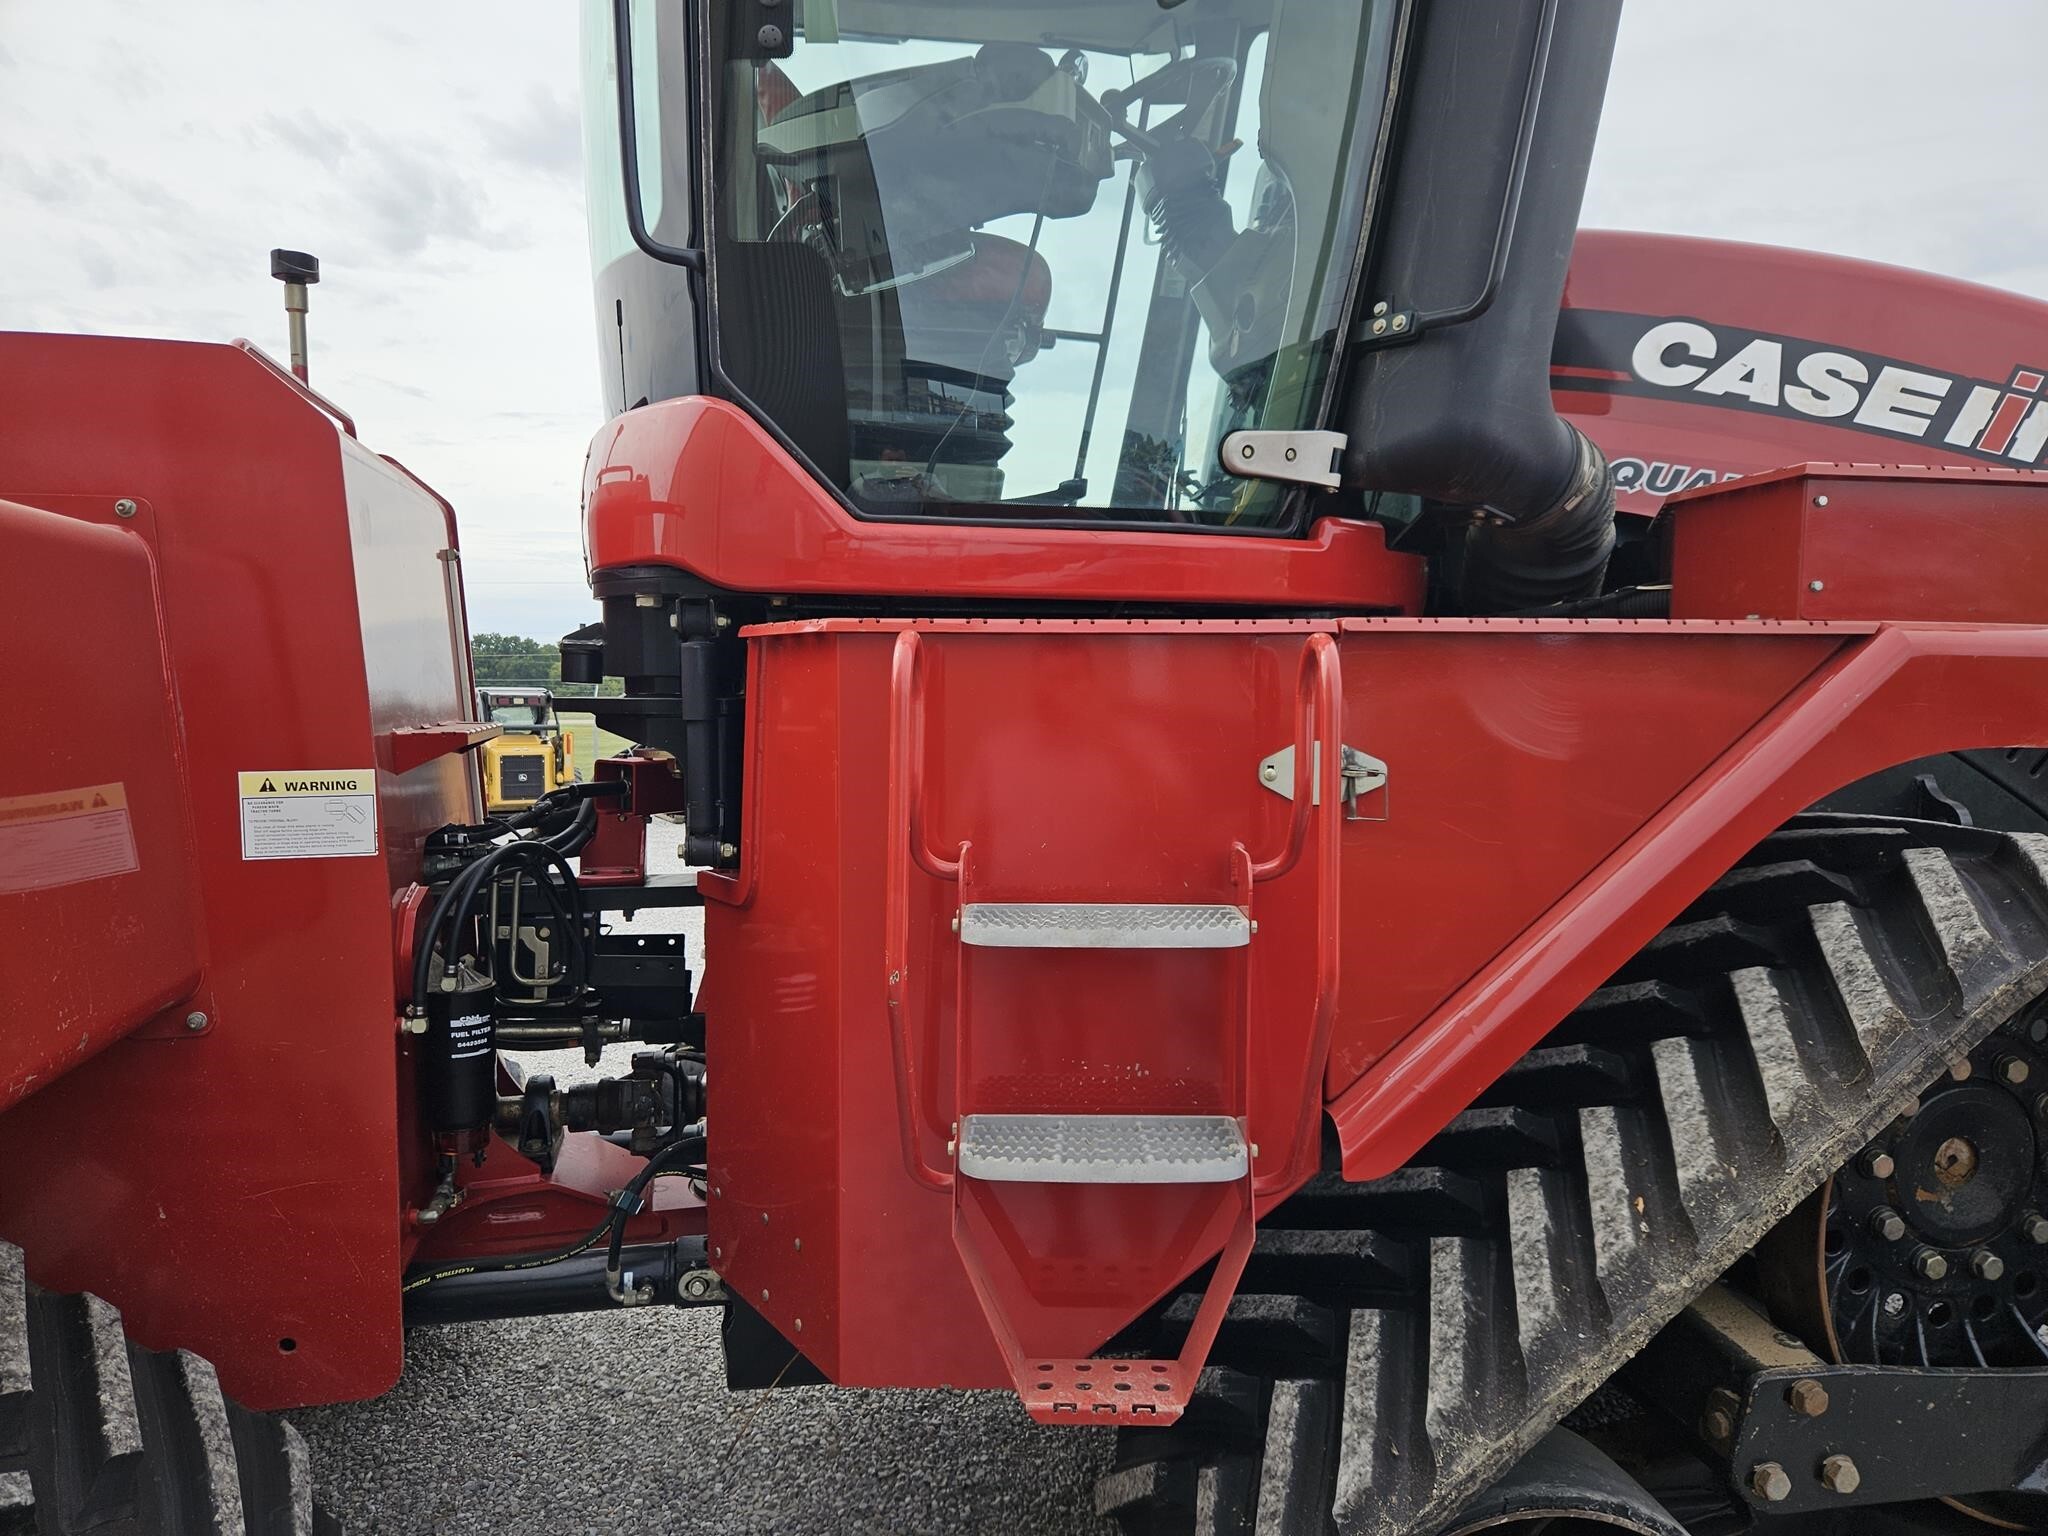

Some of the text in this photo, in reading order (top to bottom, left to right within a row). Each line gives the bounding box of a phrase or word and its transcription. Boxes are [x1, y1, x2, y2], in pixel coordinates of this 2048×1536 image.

[1632, 321, 1953, 438] CASE
[1608, 457, 1744, 496] QUA
[284, 780, 358, 792] WARNING
[471, 1025, 491, 1037] FILTER
